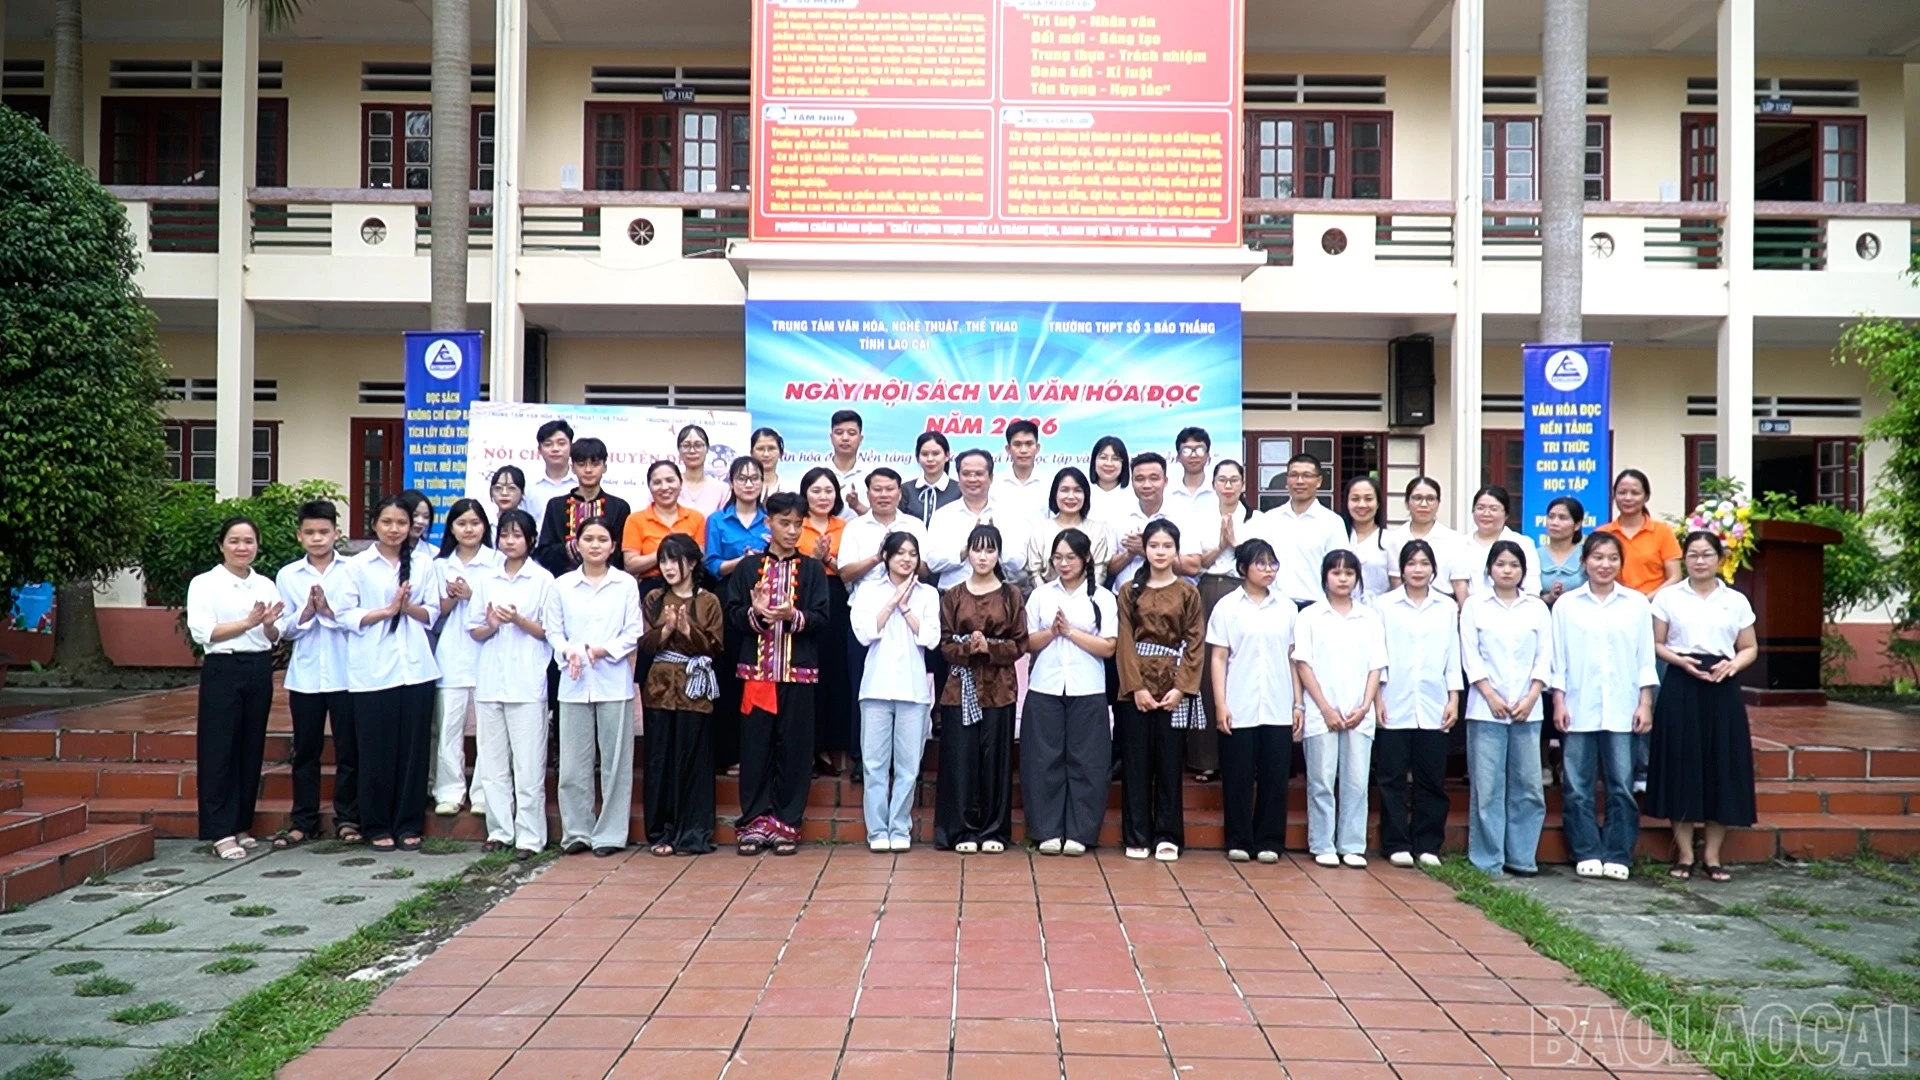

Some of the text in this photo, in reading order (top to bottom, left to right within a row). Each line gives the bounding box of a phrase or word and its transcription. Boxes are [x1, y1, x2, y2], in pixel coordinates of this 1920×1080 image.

[772, 320, 808, 332] TRUNG
[811, 318, 835, 332] TÂM
[837, 318, 859, 332] VĂN
[989, 321, 1018, 333] THAO
[1049, 319, 1092, 333] TRƯỜNG
[1095, 321, 1123, 333] THPT
[1126, 318, 1141, 333] SỐ
[1144, 322, 1151, 333] 3
[1179, 318, 1216, 334] THẮNG
[785, 378, 1200, 407] NGÀY HỘI SÁCH VÀ VĂN HÓA ĐỌC
[1532, 402, 1602, 418] VĂN HÓA ĐỌC
[926, 412, 1058, 435] NĂM 26
[1565, 419, 1593, 435] TẢNG
[484, 445, 513, 460] NÓI
[1543, 439, 1590, 453] TRI THỨC
[607, 450, 660, 466] HUYÊN
[780, 451, 795, 463] ăn
[799, 451, 821, 462] hóa
[1536, 458, 1596, 474] CHO XÃ HỘI
[1543, 476, 1589, 492] HỌC TẬP
